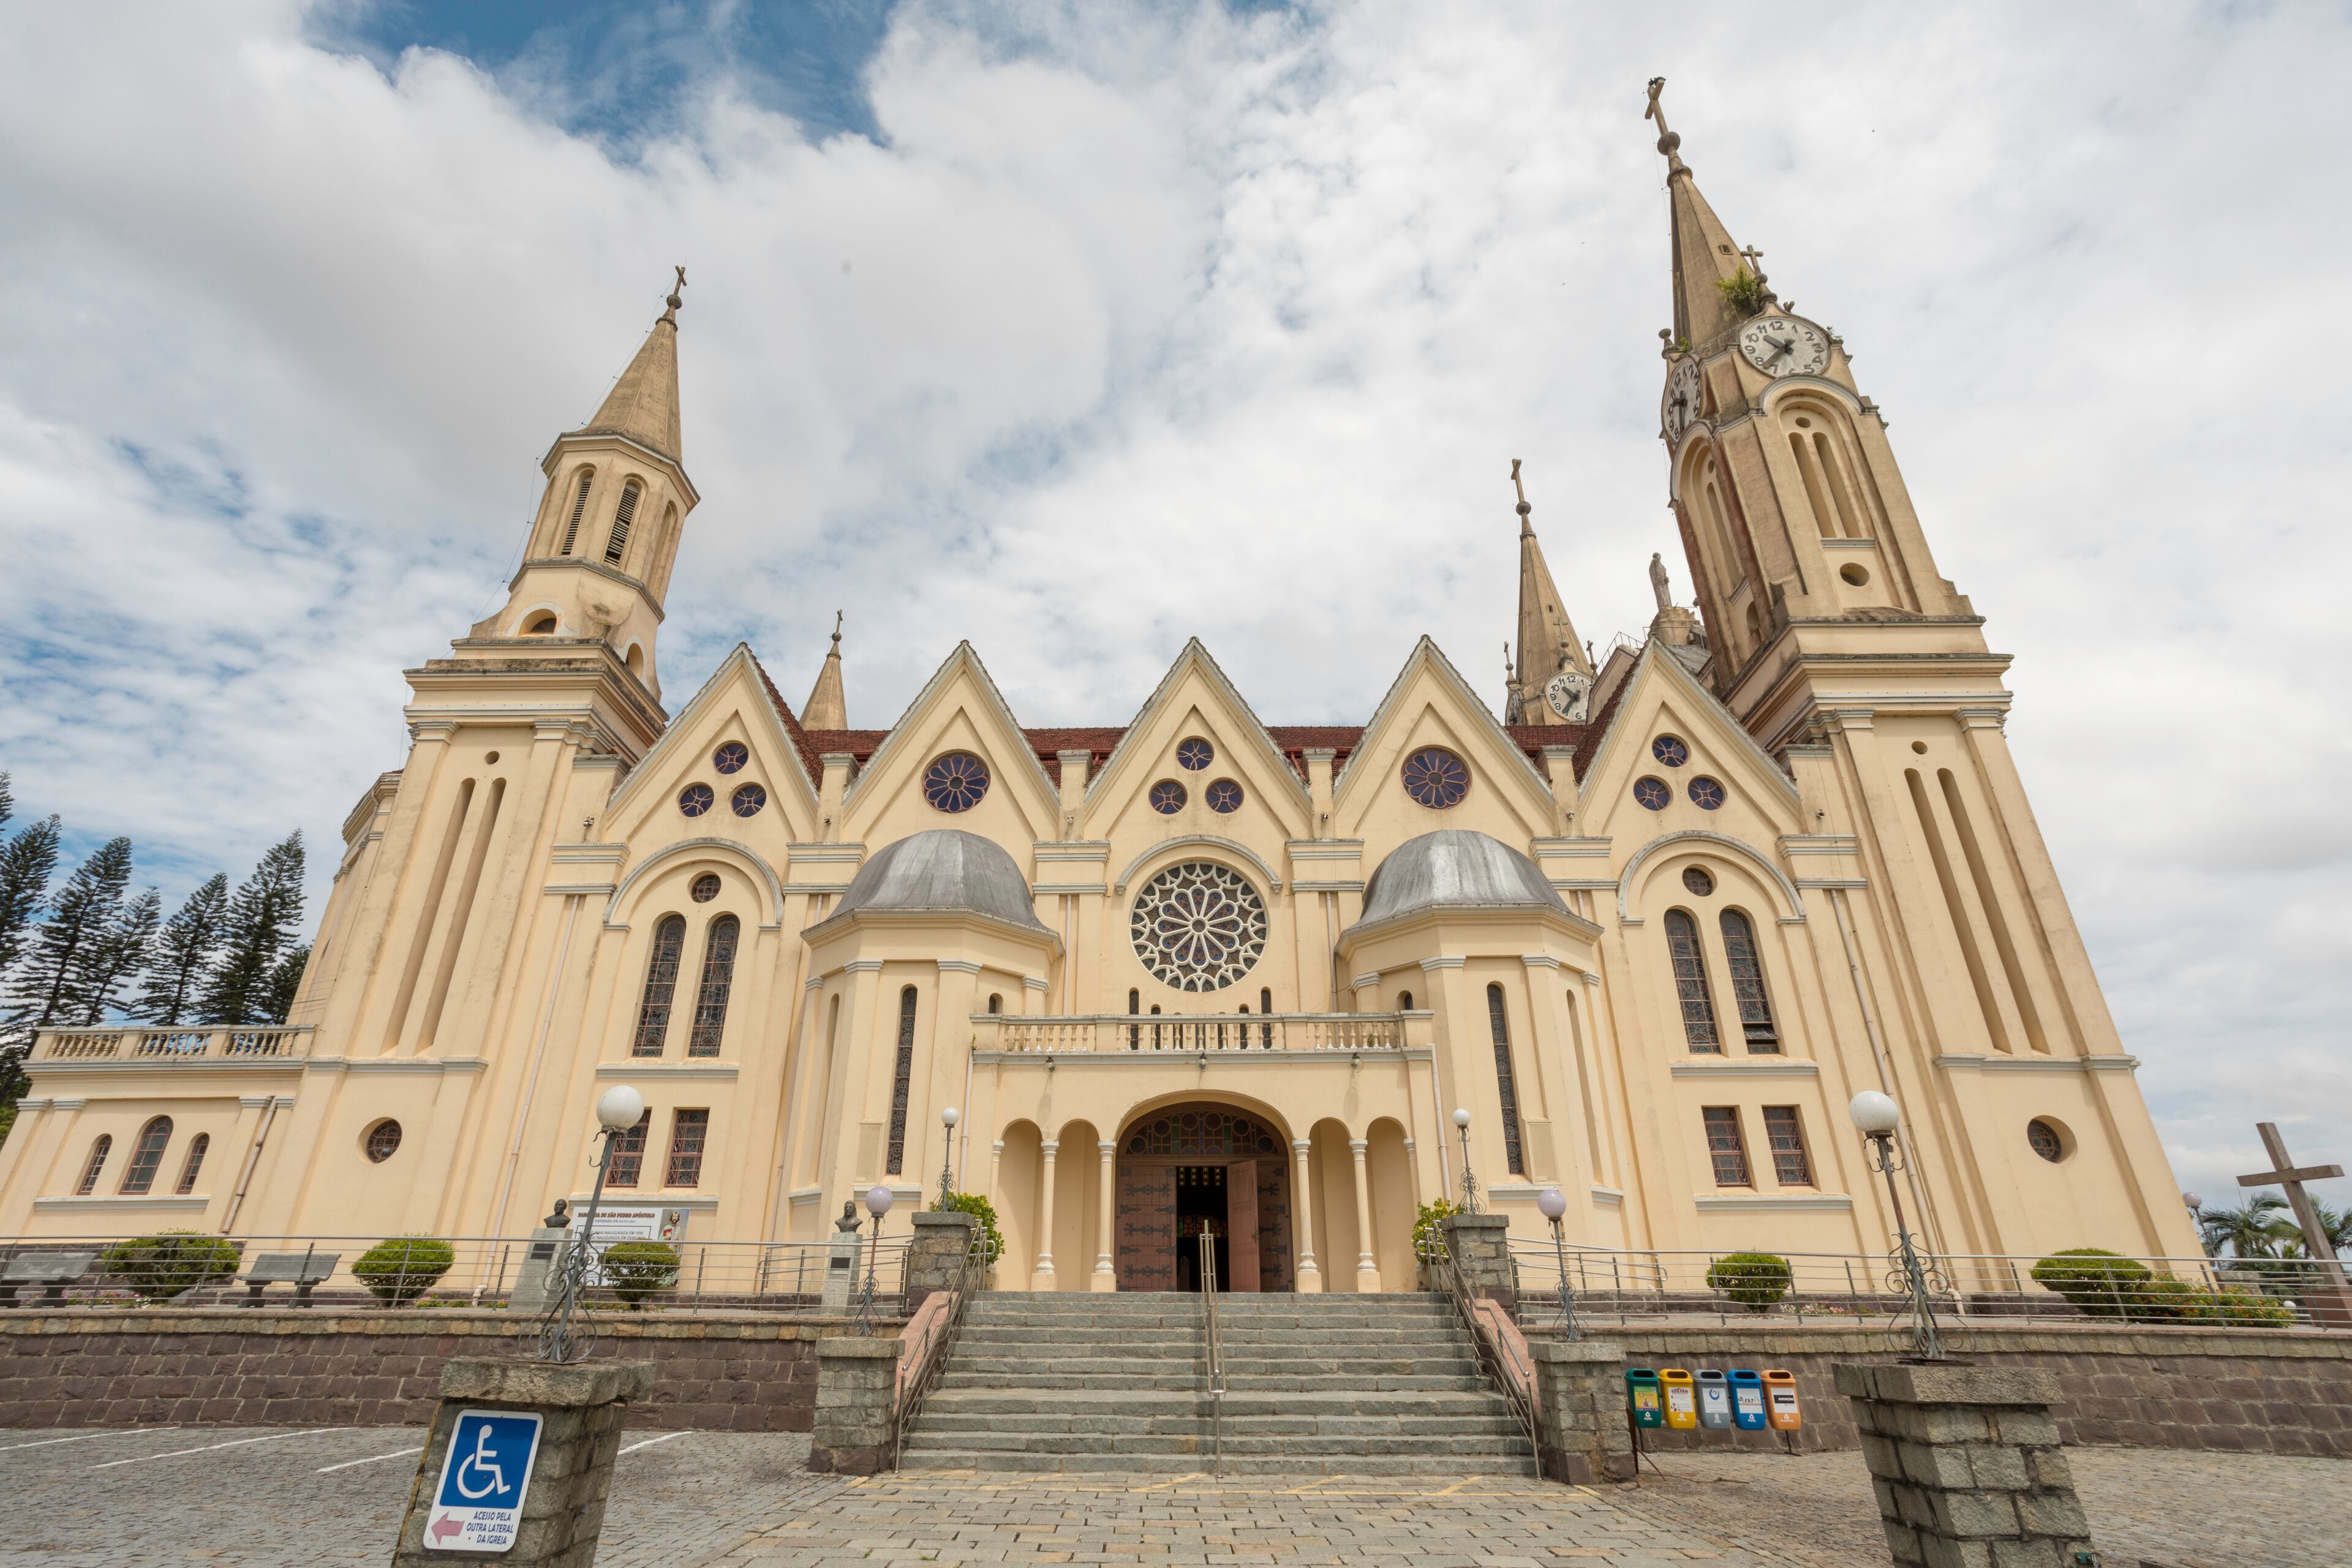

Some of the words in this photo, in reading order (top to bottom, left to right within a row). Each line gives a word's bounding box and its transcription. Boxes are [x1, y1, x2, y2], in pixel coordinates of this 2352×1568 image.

[1756, 324, 1767, 333] 11
[1770, 321, 1785, 330] 12
[1792, 324, 1798, 333] 1
[1745, 333, 1759, 342] 10
[1805, 331, 1815, 341] 2
[1744, 345, 1756, 355] 9
[1812, 343, 1824, 353] 3
[1754, 356, 1764, 366] 8
[1812, 355, 1823, 364] 4
[1683, 366, 1687, 379] 1
[1689, 364, 1694, 378] 2
[1770, 364, 1778, 374] 7
[1804, 364, 1815, 373] 5
[1693, 403, 1699, 418] 5
[1669, 420, 1674, 431] 9
[1675, 427, 1679, 439] 8
[473, 1511, 495, 1520] ACESSO
[496, 1512, 511, 1521] PELA
[467, 1523, 486, 1532] OUTRA
[488, 1523, 513, 1533] LATERAL
[477, 1534, 486, 1543] DA
[486, 1535, 507, 1545] IGREJA
